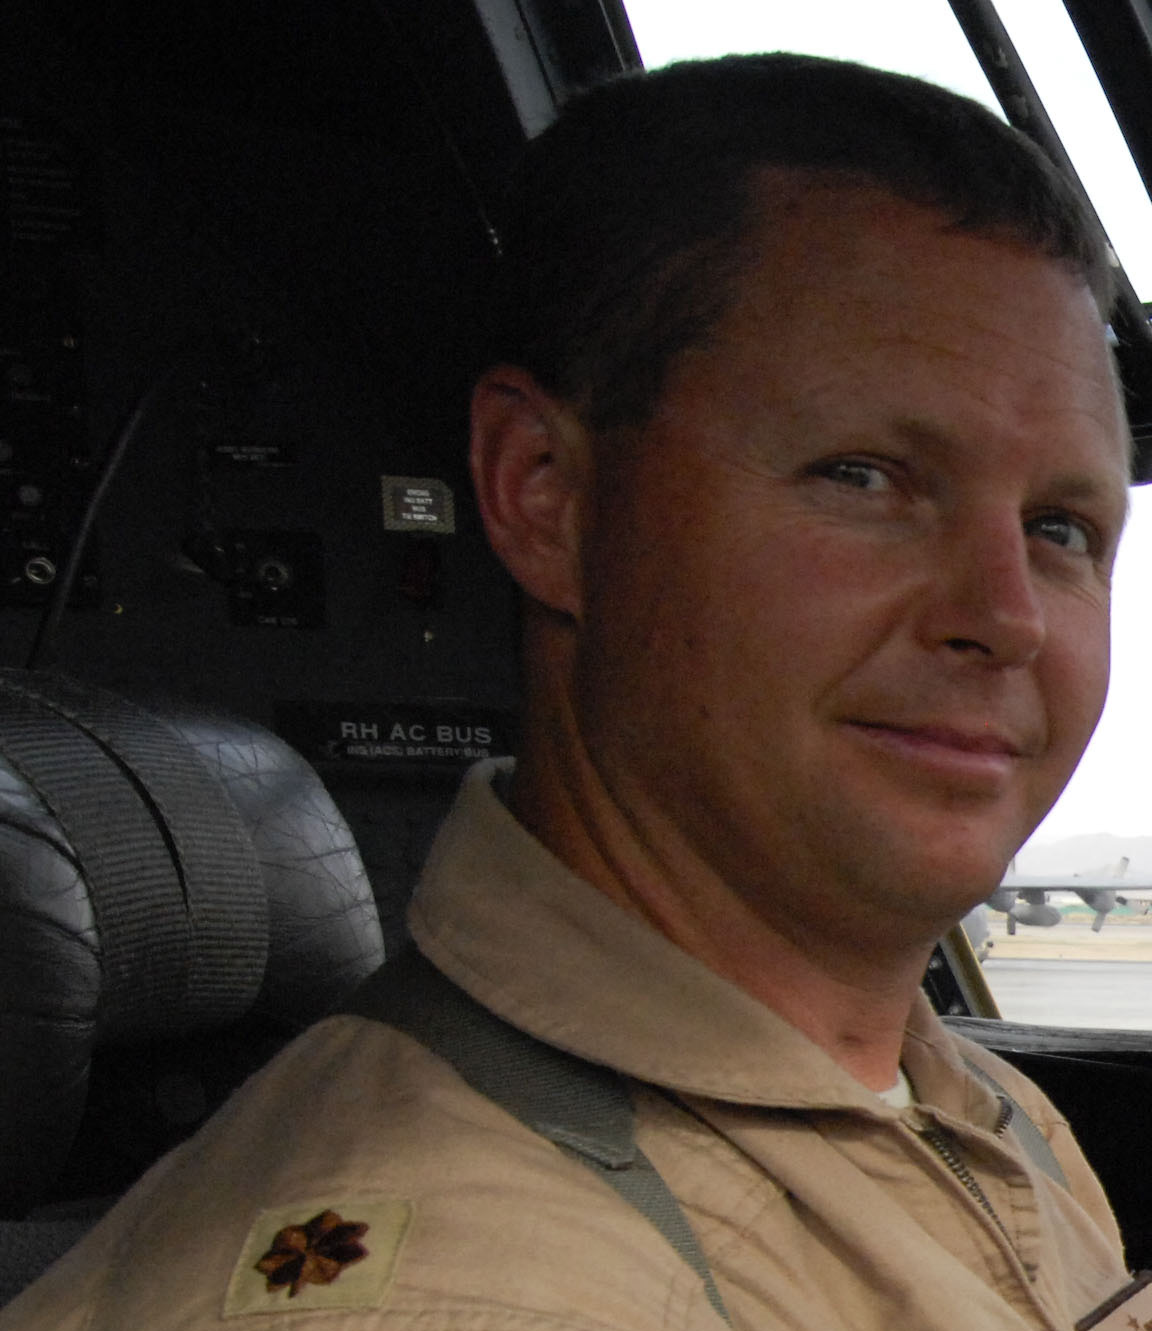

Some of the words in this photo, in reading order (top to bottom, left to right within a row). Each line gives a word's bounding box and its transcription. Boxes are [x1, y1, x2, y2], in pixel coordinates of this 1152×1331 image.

[340, 721, 379, 741] RH
[389, 723, 428, 742] AC
[436, 725, 493, 745] BUS
